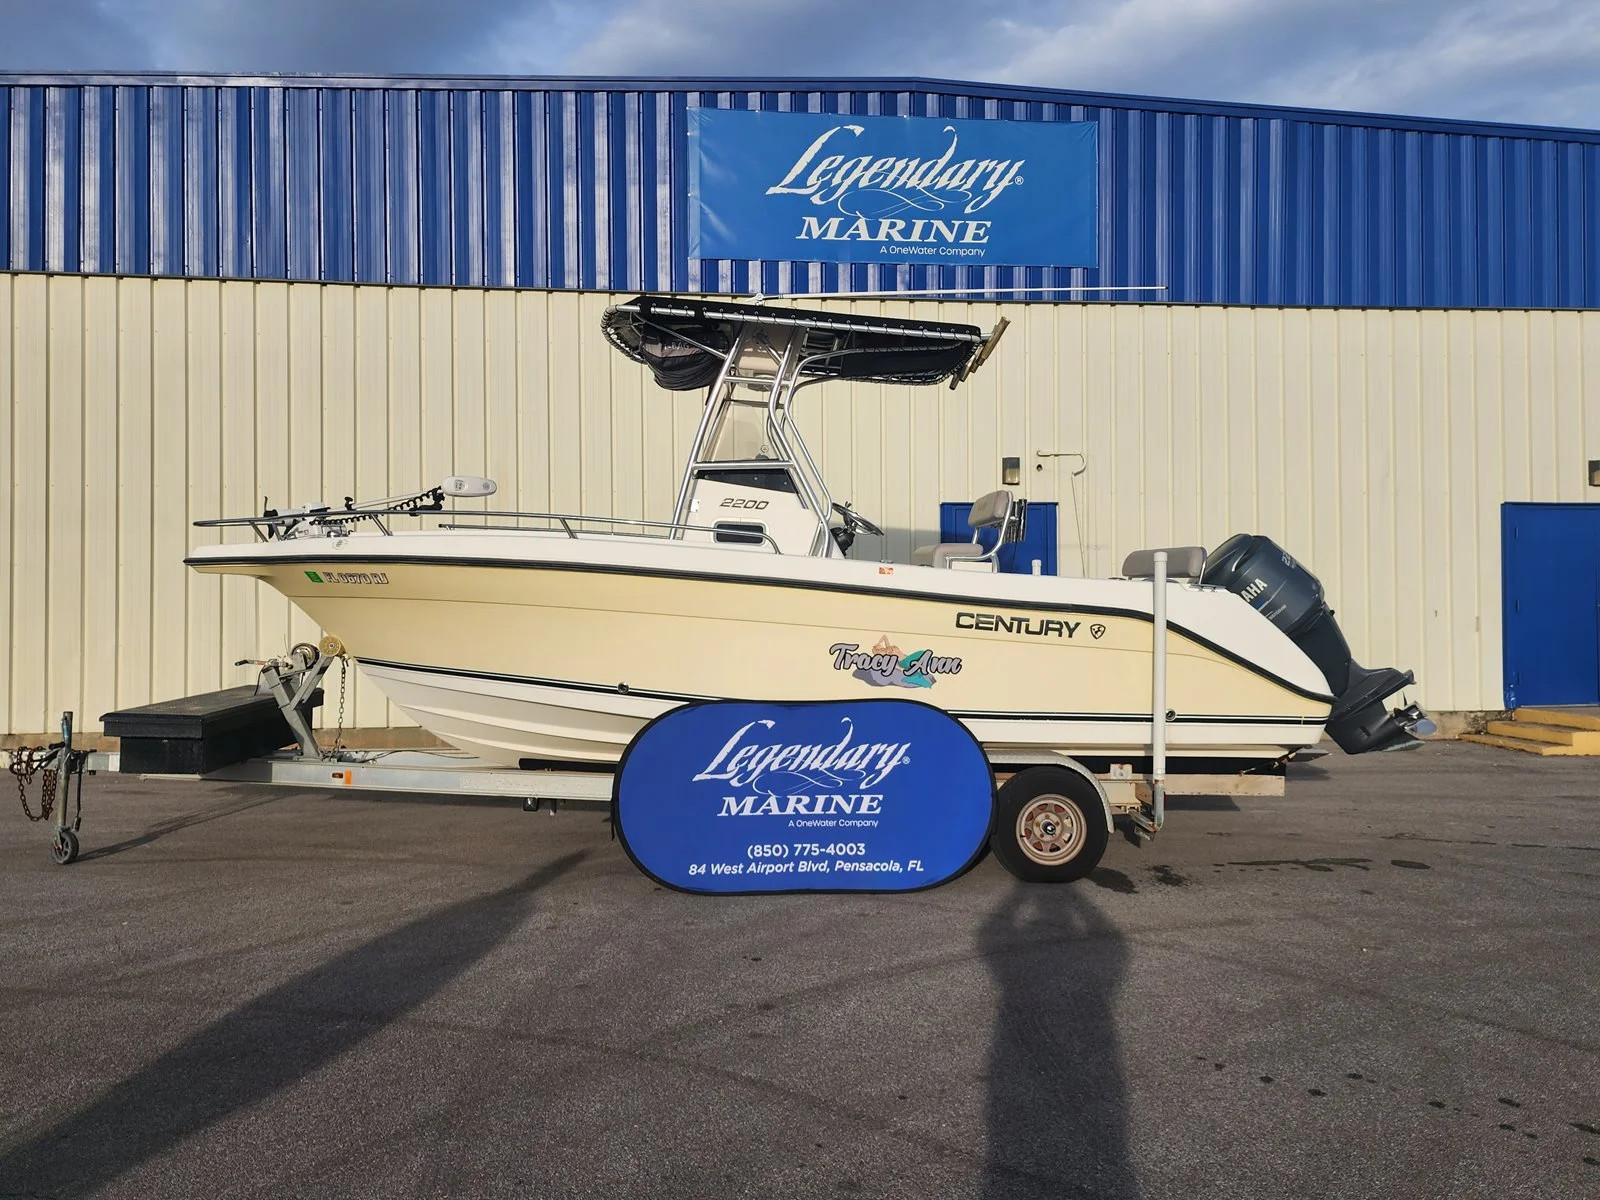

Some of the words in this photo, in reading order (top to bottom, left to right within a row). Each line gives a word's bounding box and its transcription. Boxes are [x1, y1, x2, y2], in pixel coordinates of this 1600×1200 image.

[795, 215, 992, 244] MARINE
[879, 245, 887, 254] A
[889, 245, 937, 255] OneWater
[938, 246, 986, 257] Company
[719, 498, 770, 510] 2200
[1240, 578, 1268, 602] AHA
[955, 611, 1082, 639] CENTURY
[829, 642, 900, 677] Tracy
[903, 649, 963, 676] Ann
[716, 791, 884, 817] MARINE
[788, 820, 795, 828] A
[796, 819, 838, 828] OneWater
[838, 818, 879, 828] Company
[747, 844, 789, 858] (850)
[793, 843, 866, 856] 775-4003
[688, 864, 706, 876] 84
[710, 863, 743, 874] West
[746, 861, 794, 875] Airport
[798, 860, 831, 873] Blvd,
[834, 860, 904, 873] Pensacola,
[907, 860, 925, 871] FL
